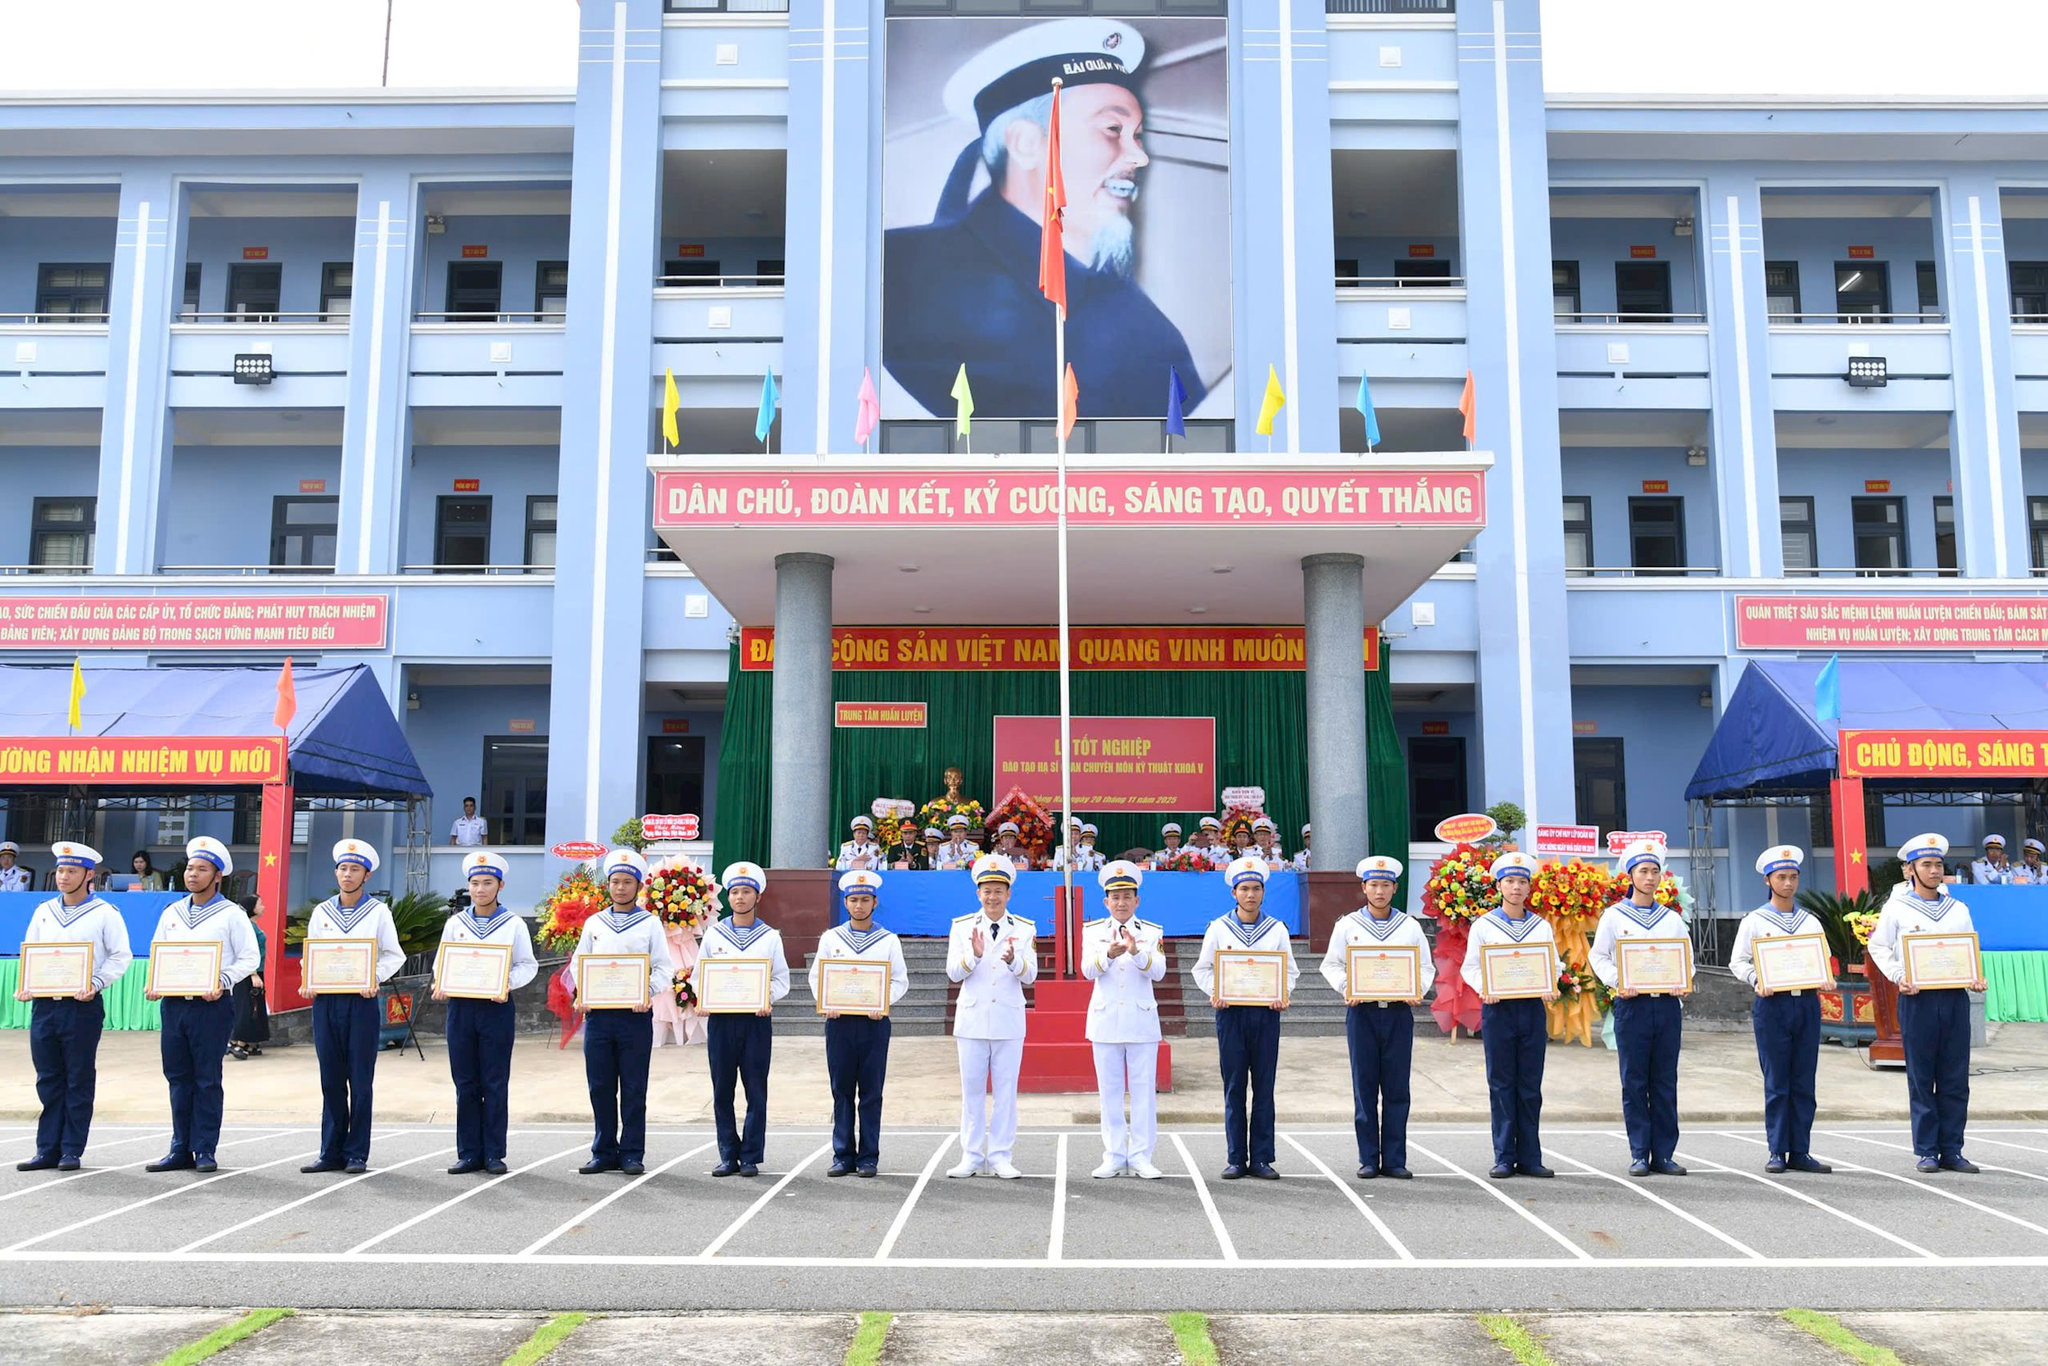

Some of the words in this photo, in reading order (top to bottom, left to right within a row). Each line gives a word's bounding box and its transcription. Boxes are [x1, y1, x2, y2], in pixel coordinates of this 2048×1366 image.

[669, 482, 727, 514] DÂN
[737, 479, 801, 516] CHỦ,
[810, 482, 894, 513] ĐOÀN
[899, 479, 954, 516] KẾT,
[964, 478, 1000, 513] KỶ
[1125, 482, 1202, 513] SÁNG
[1212, 486, 1272, 519] TẠO,
[1282, 478, 1369, 516] QUYẾT
[1378, 477, 1471, 513] THẮNG
[15, 604, 35, 619] SỨC
[38, 602, 68, 619] CHIẾN
[70, 602, 91, 619] ĐẤU
[93, 603, 114, 619] CỦA
[117, 603, 136, 619] CÁC
[139, 602, 160, 619] CẤP
[163, 603, 176, 620] ỦY,
[179, 601, 192, 619] TỔ
[194, 603, 221, 618] CHỨC
[224, 602, 254, 620] ĐẢNG;
[257, 603, 282, 618] PHÁT
[285, 605, 305, 618] HUY
[308, 603, 340, 618] TRÁCH
[343, 602, 376, 621] NHIỆM
[1746, 603, 1771, 620] QUÁN
[1773, 603, 1798, 622] TRIỆT
[1800, 604, 1818, 619] SÂU
[1821, 602, 1840, 619] SẮC
[1842, 604, 1868, 622] MỆNH
[1870, 604, 1894, 622] LỆNH
[1896, 603, 1921, 619] HUẤN
[1923, 604, 1952, 622] LUYỆN
[1954, 603, 1982, 620] CHIẾN
[1983, 603, 2005, 621] ĐẤU;
[2007, 604, 2028, 620] BÁM
[2030, 604, 2047, 620] SÁT
[1, 623, 28, 640] ĐẢNG
[32, 625, 56, 641] VIÊN;
[60, 625, 80, 640] XÂY
[82, 626, 109, 643] DỰNG
[112, 623, 140, 640] ĐẢNG
[142, 625, 157, 643] BỘ
[159, 627, 192, 640] TRONG
[195, 627, 221, 643] SẠCH
[224, 625, 251, 640] VỮNG
[254, 627, 285, 642] MẠNH
[288, 625, 308, 640] TIÊU
[311, 622, 335, 640] BIỂU
[1806, 626, 1836, 643] NHIỆM
[1838, 628, 1850, 643] VỤ
[1852, 624, 1878, 641] HUẤN
[1880, 626, 1911, 643] LUYỆN;
[1913, 626, 1931, 641] XÂY
[1933, 627, 1959, 643] DỰNG
[1960, 628, 1991, 641] TRUNG
[1992, 626, 2013, 641] TÂM
[2015, 626, 2040, 641] CÁCH
[897, 631, 947, 662] SẢN
[956, 633, 1005, 666] VIỆT
[1079, 638, 1160, 665] QUANG
[1168, 638, 1225, 661] VINH
[1233, 633, 1304, 661] MUÔN
[840, 710, 862, 721] TRUNG
[864, 708, 879, 721] TÂM
[880, 706, 900, 721] HUẤN
[901, 708, 923, 724] LUYỆN
[1072, 733, 1098, 756] TỐT
[1102, 736, 1152, 759] NGHIỆP
[1857, 737, 1901, 767] CHỦ
[1908, 738, 1972, 771] ĐỘNG,
[1978, 739, 2034, 767] SÁNG
[58, 746, 115, 777] NHẬN
[122, 746, 188, 777] NHIỆM
[195, 749, 223, 777] VỤ
[230, 746, 271, 773] MỚI
